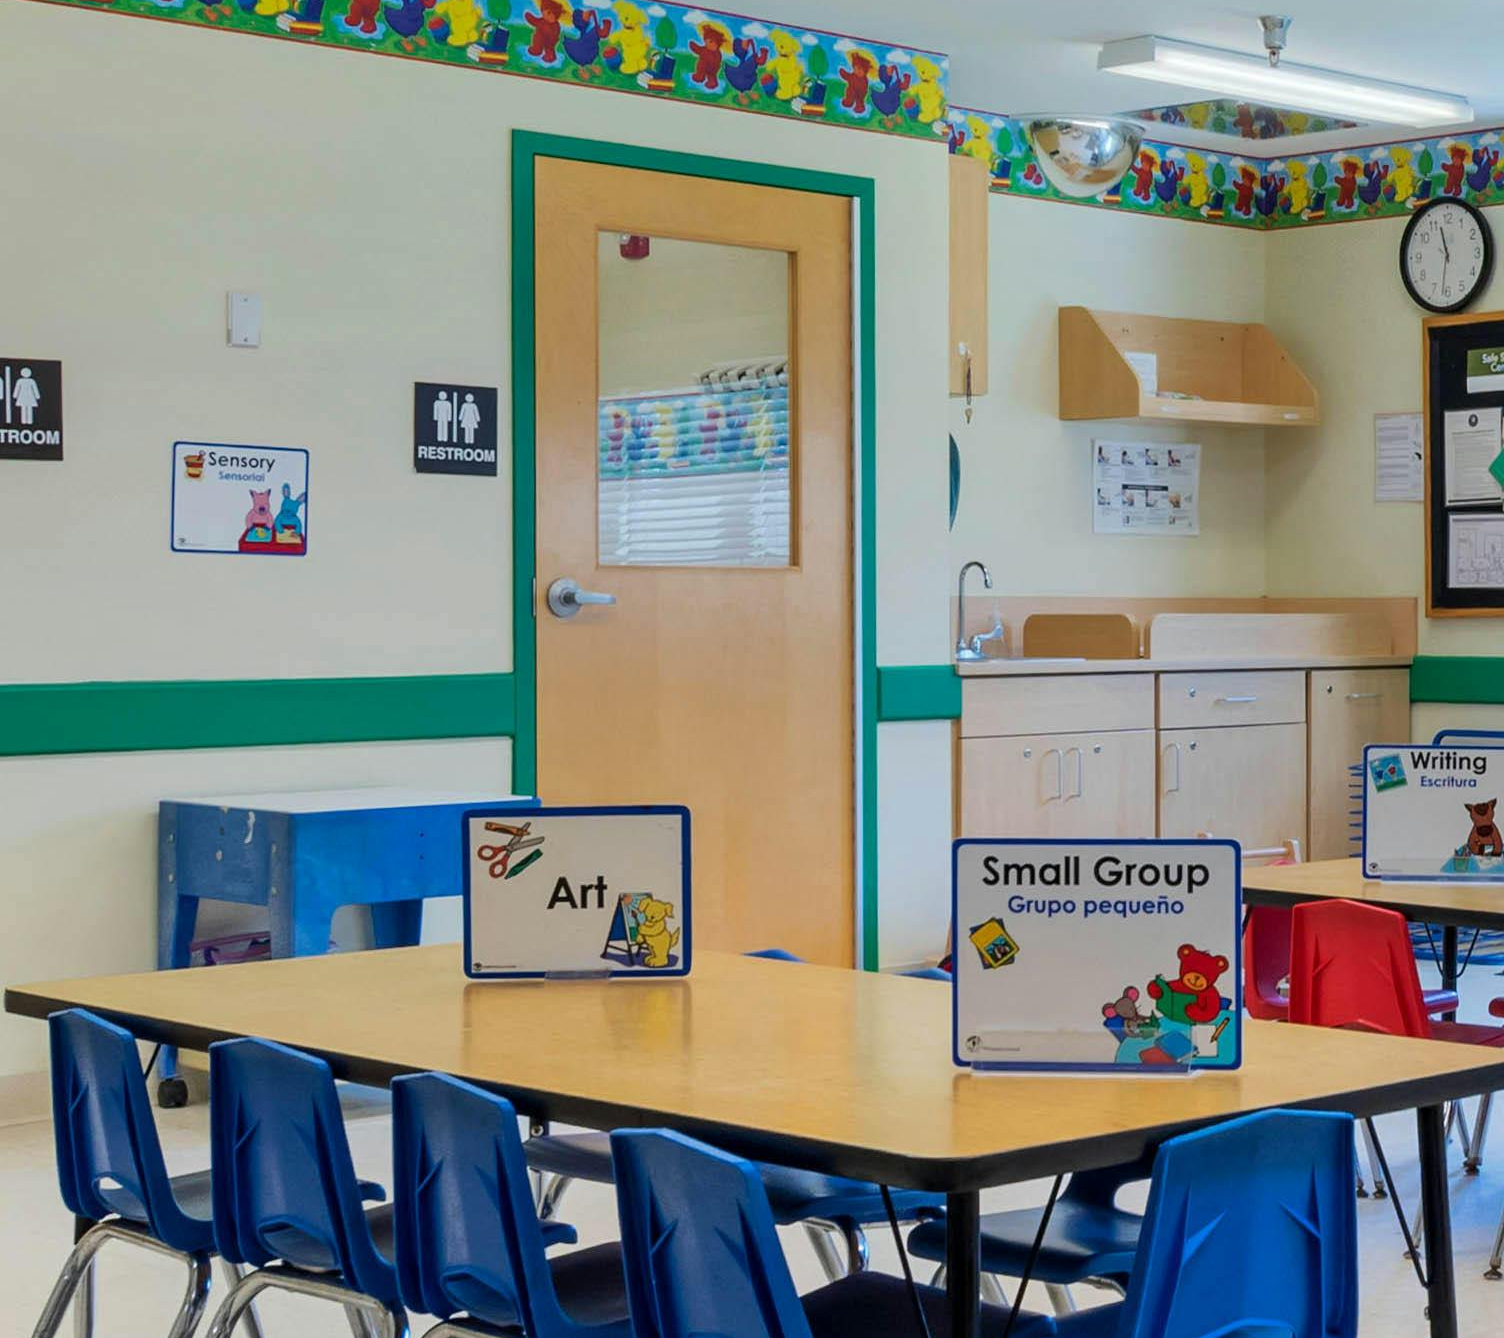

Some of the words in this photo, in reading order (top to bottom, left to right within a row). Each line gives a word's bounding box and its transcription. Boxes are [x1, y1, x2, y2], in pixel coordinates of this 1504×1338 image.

[1442, 212, 1453, 224] 12
[1429, 220, 1438, 231] 11
[1420, 232, 1430, 244] 10
[1469, 229, 1477, 240] 2
[1415, 252, 1422, 263] 9
[1474, 247, 1481, 259] 3
[1419, 269, 1426, 281] 8
[1469, 266, 1476, 277] 4
[1431, 283, 1438, 293] 7
[1444, 286, 1452, 298] 6
[1458, 280, 1466, 292] 5
[1481, 352, 1499, 363] Safe
[417, 445, 496, 463] RESTROOM
[208, 451, 276, 472] Sensory
[218, 471, 266, 482] Sensorial
[1410, 751, 1487, 775] Writing
[1420, 775, 1477, 787] Escritura
[981, 855, 1080, 886] Small
[1093, 856, 1210, 893] Group
[546, 875, 608, 910] Art
[1007, 895, 1076, 917] Grupo
[1083, 896, 1185, 918] pequeño
